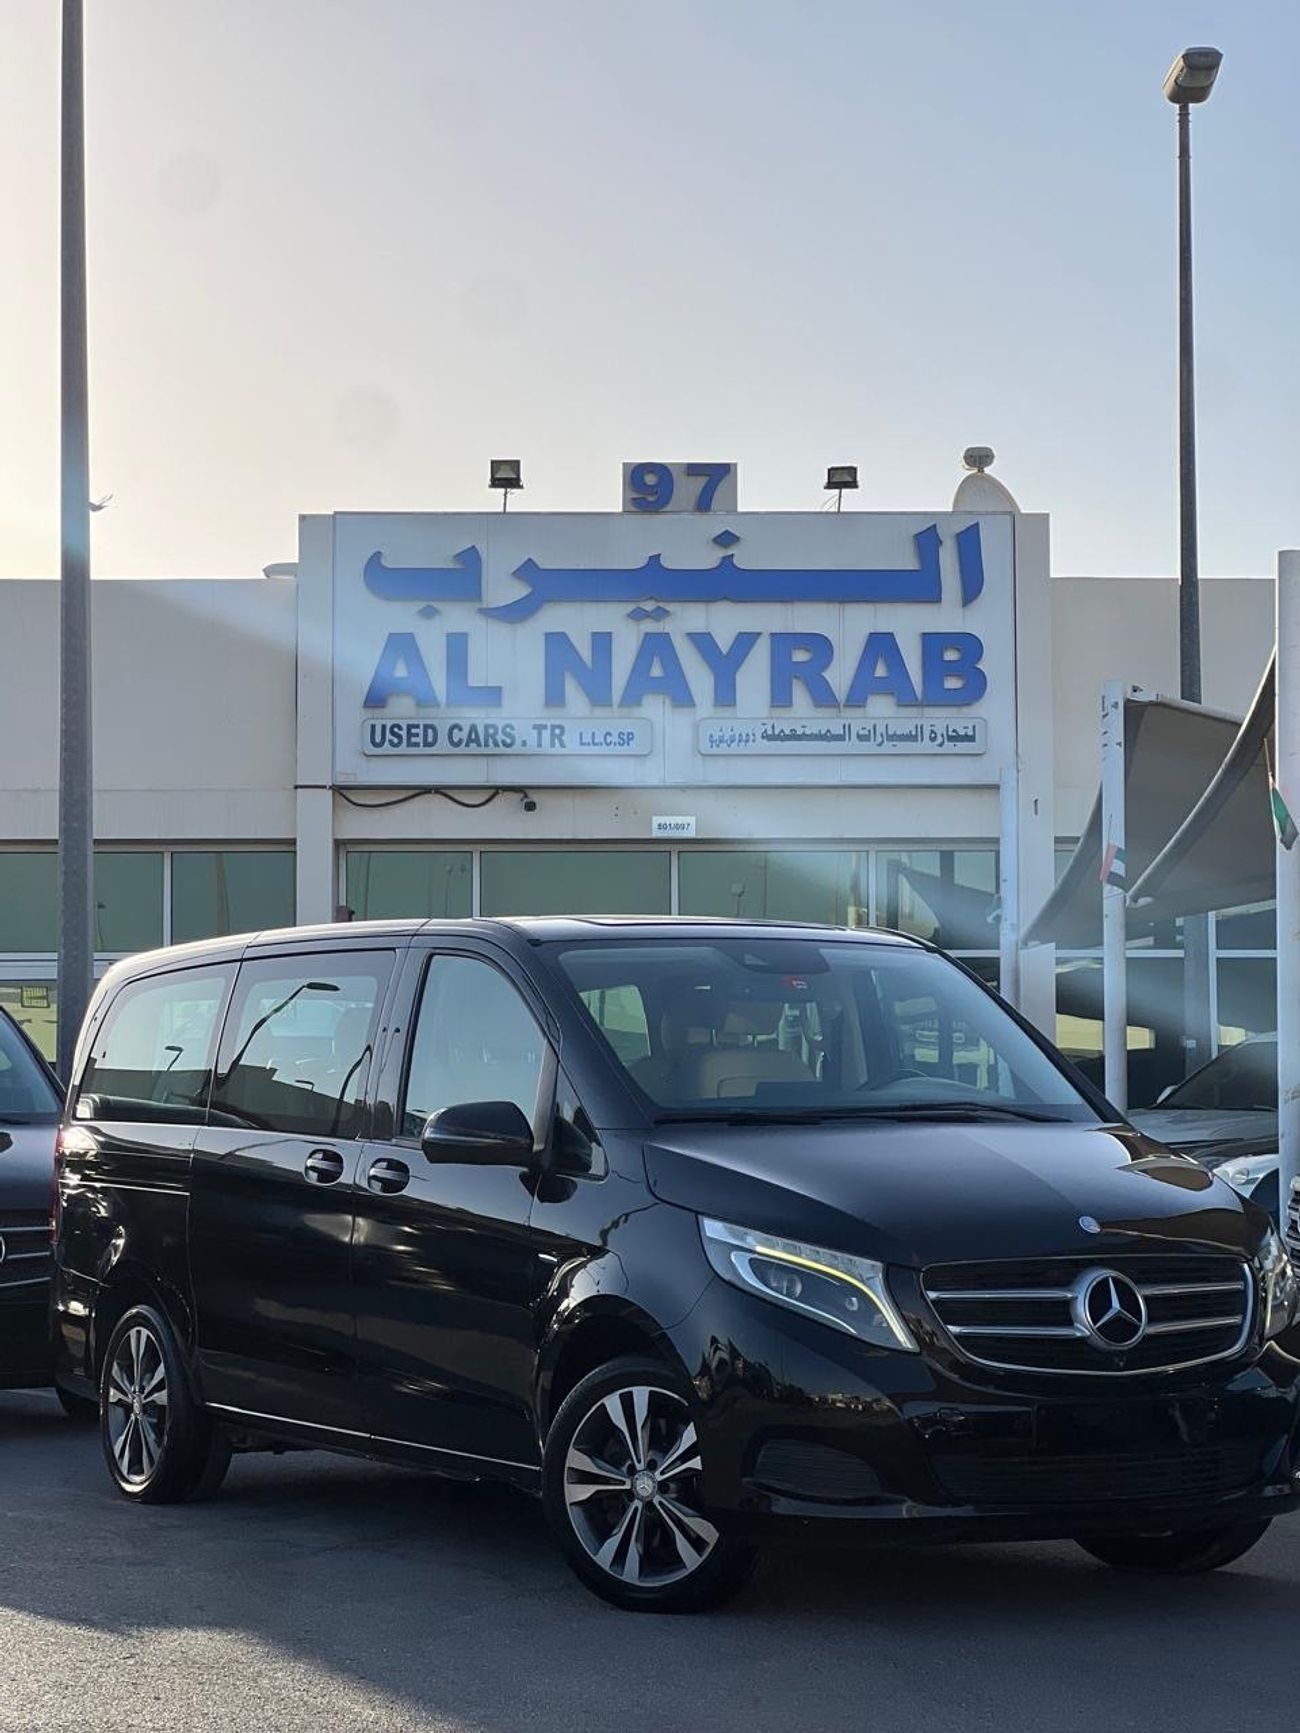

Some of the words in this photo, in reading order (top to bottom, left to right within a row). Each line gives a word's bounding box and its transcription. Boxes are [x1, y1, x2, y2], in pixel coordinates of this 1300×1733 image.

[630, 462, 731, 512] 97
[363, 522, 984, 623] النيرب
[362, 631, 503, 708] AL
[544, 631, 988, 708] NAYRAB
[370, 723, 438, 748] USED
[761, 722, 851, 743] المستعملة
[856, 723, 924, 748] السيارات
[928, 724, 976, 747] لتجارة
